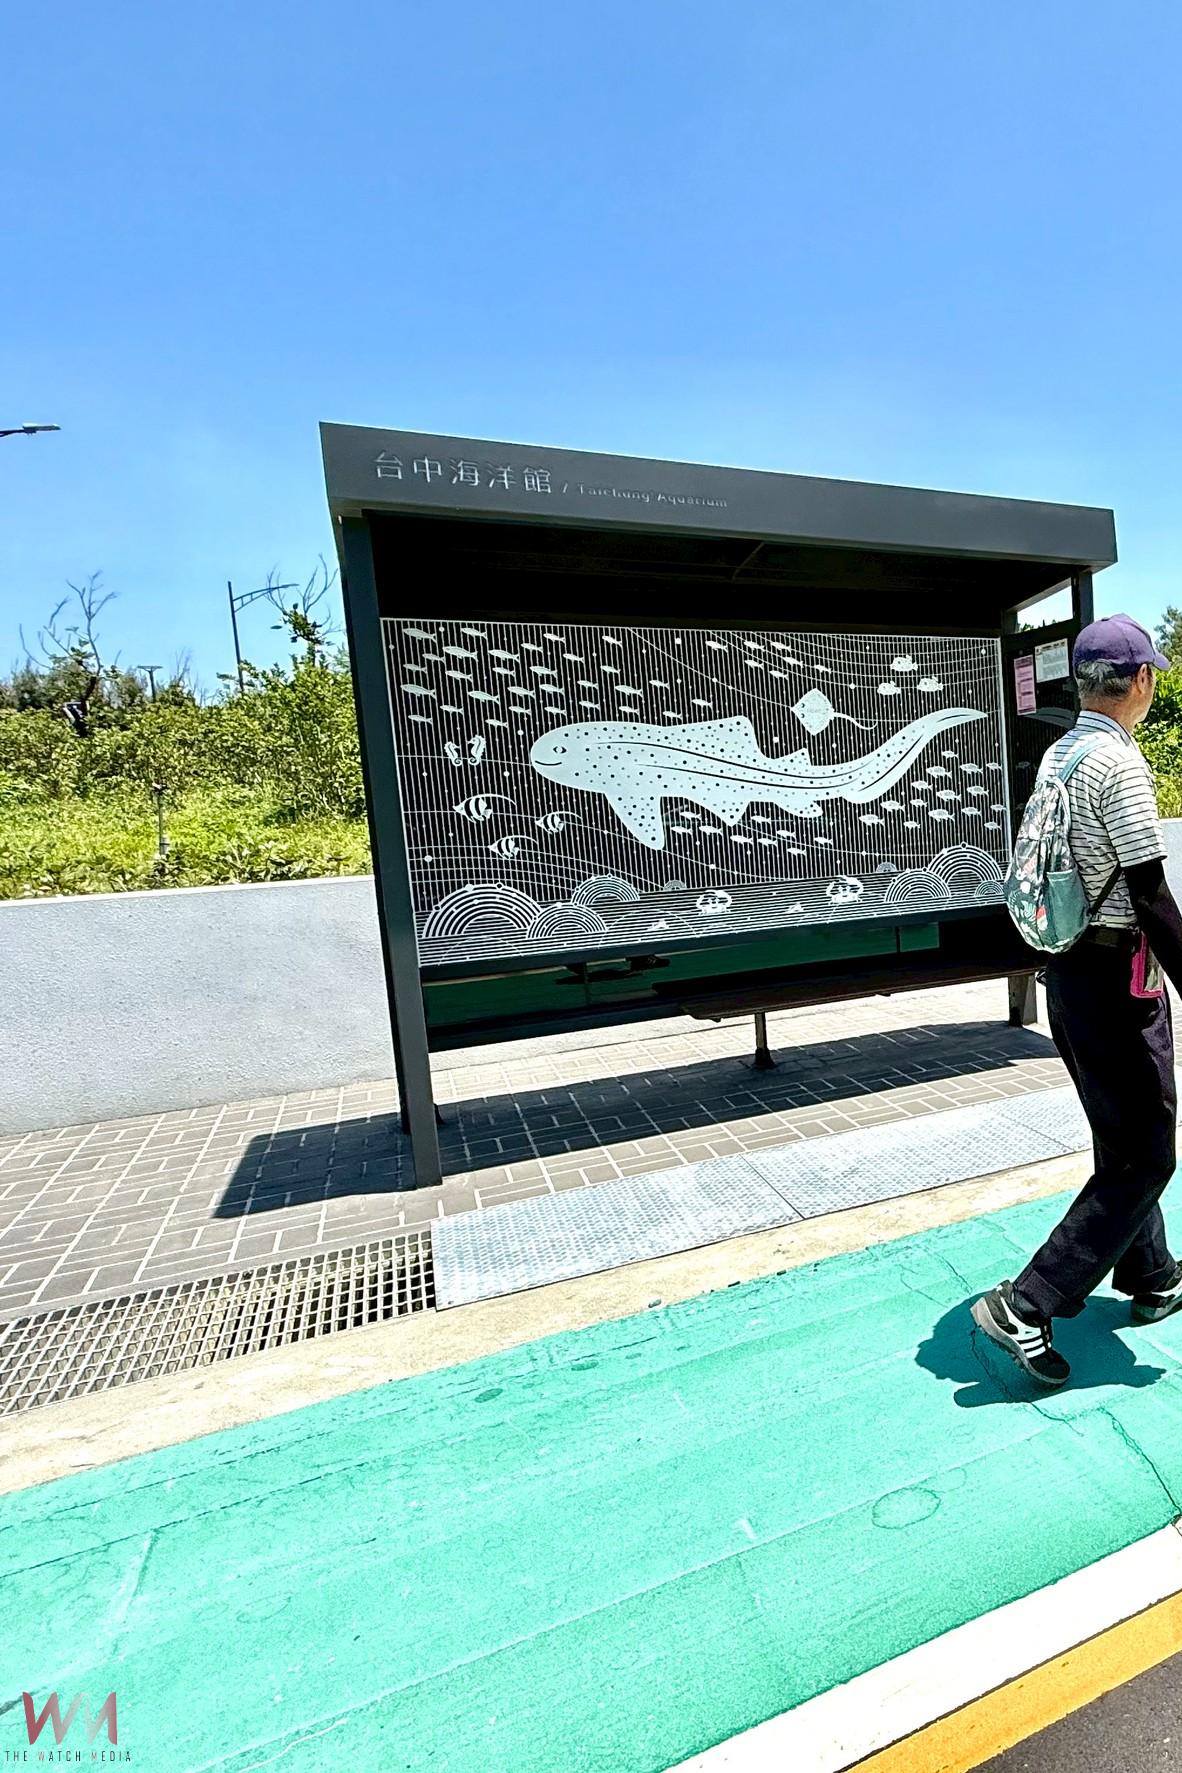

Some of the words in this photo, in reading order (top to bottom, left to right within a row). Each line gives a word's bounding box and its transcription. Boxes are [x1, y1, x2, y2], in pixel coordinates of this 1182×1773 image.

[374, 450, 552, 494] 台中海洋館
[577, 481, 650, 503] Taichung
[657, 493, 728, 508] Aquarium
